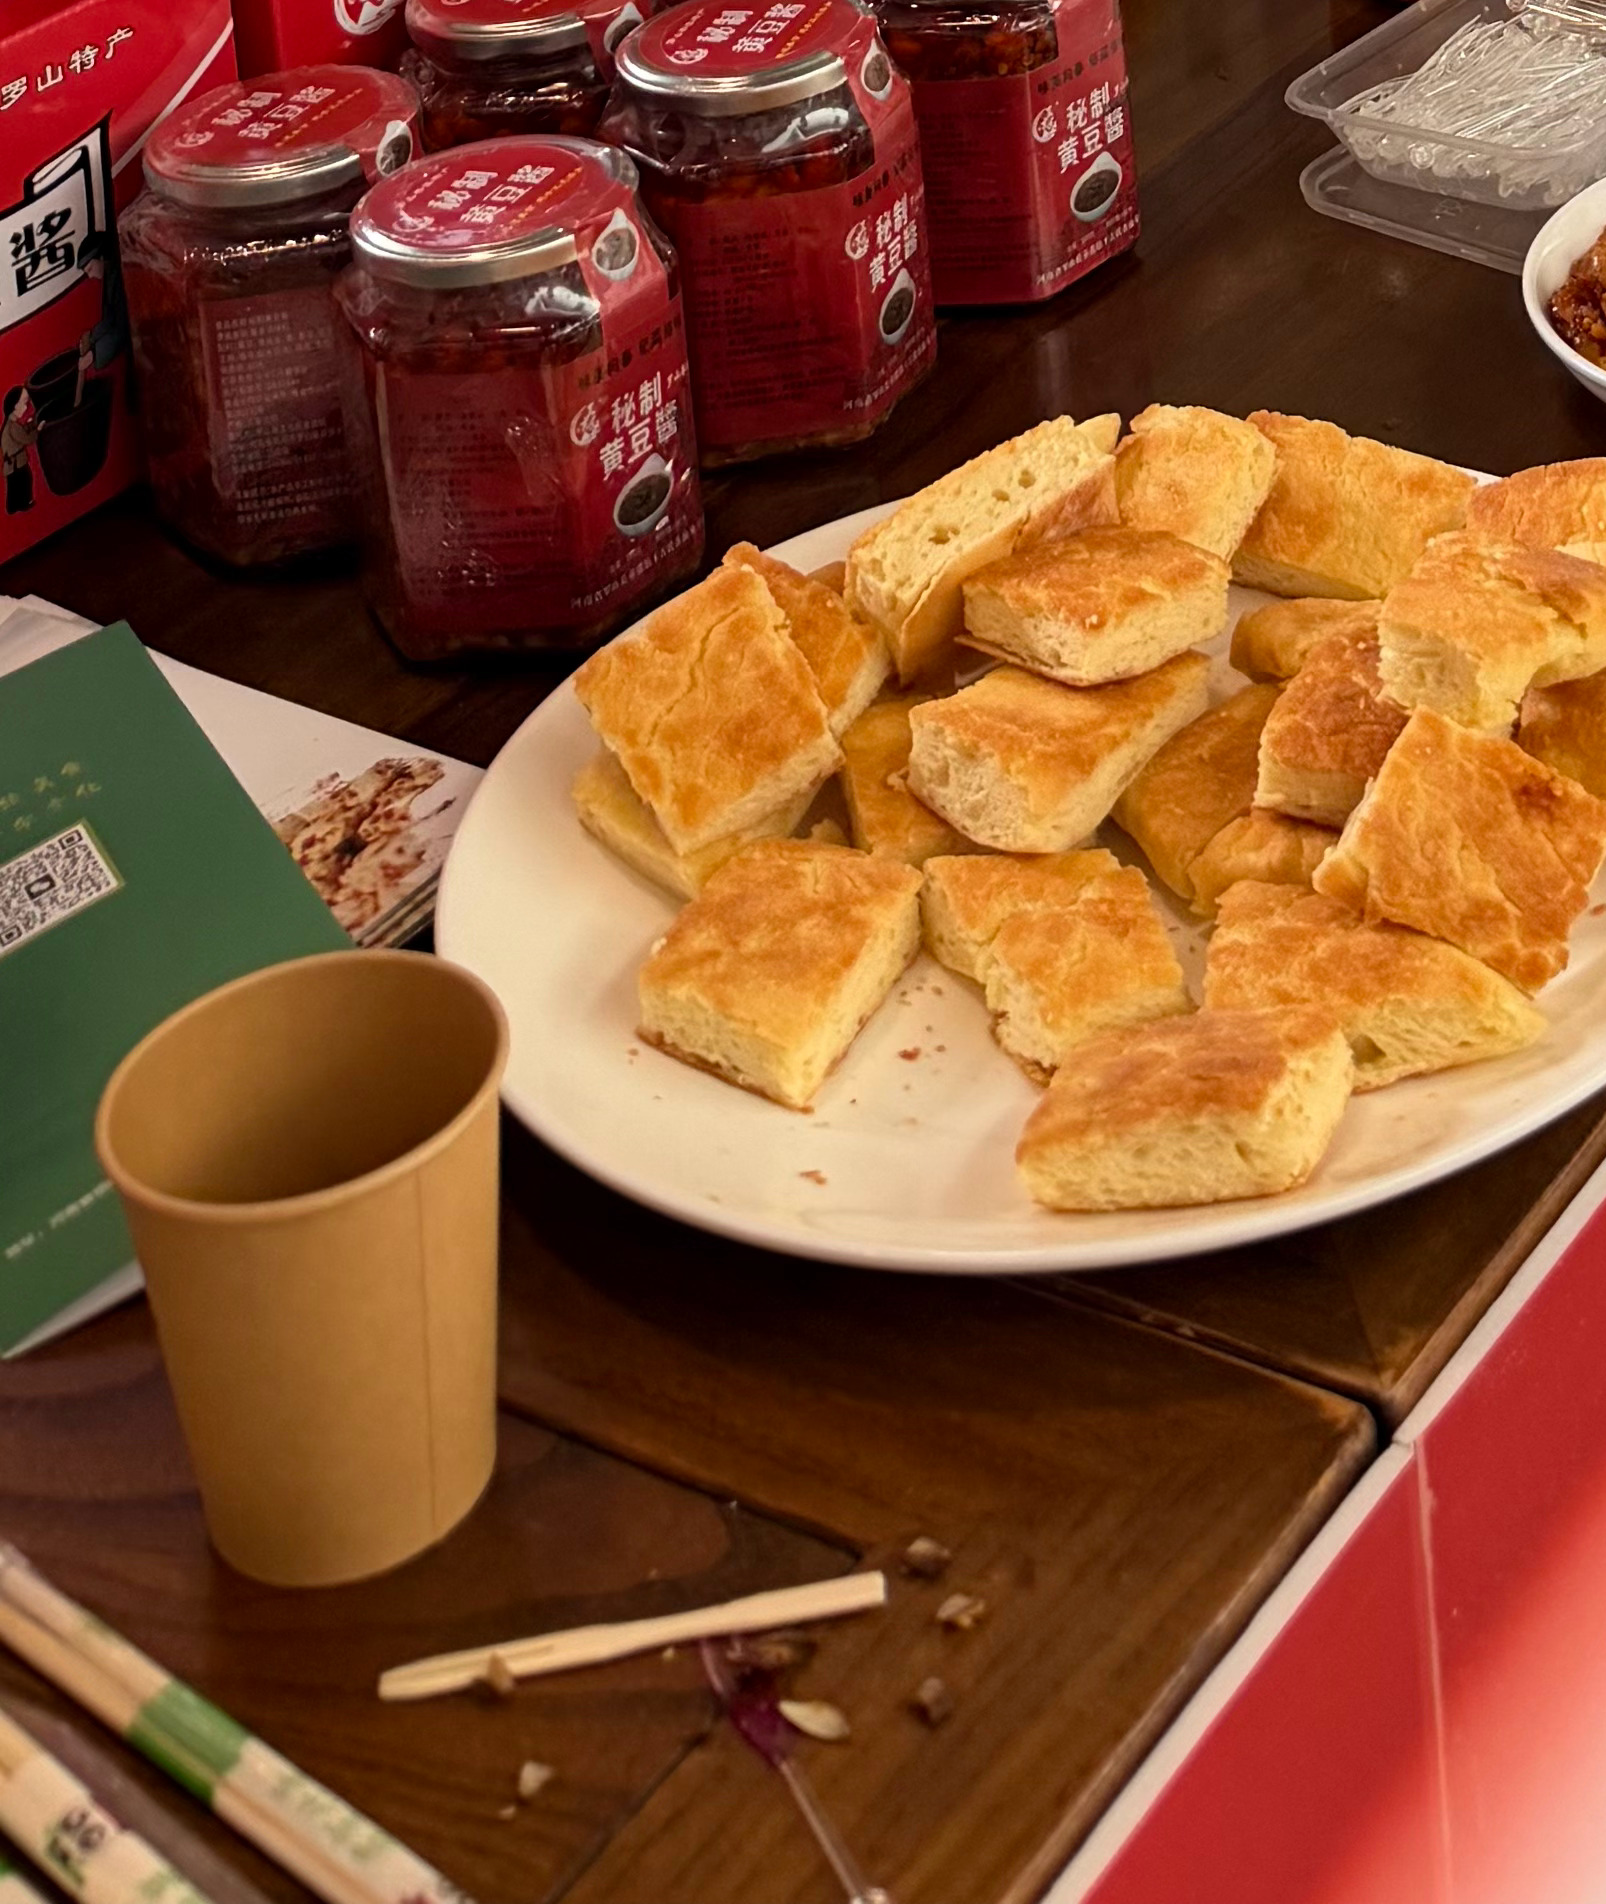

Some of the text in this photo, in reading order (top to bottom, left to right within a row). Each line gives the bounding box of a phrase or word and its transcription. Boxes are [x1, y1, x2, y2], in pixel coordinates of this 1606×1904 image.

[0, 26, 135, 112] 罗山特产
[1066, 81, 1110, 133] 秘制
[9, 206, 76, 298] 酱
[611, 371, 662, 434] 秘制
